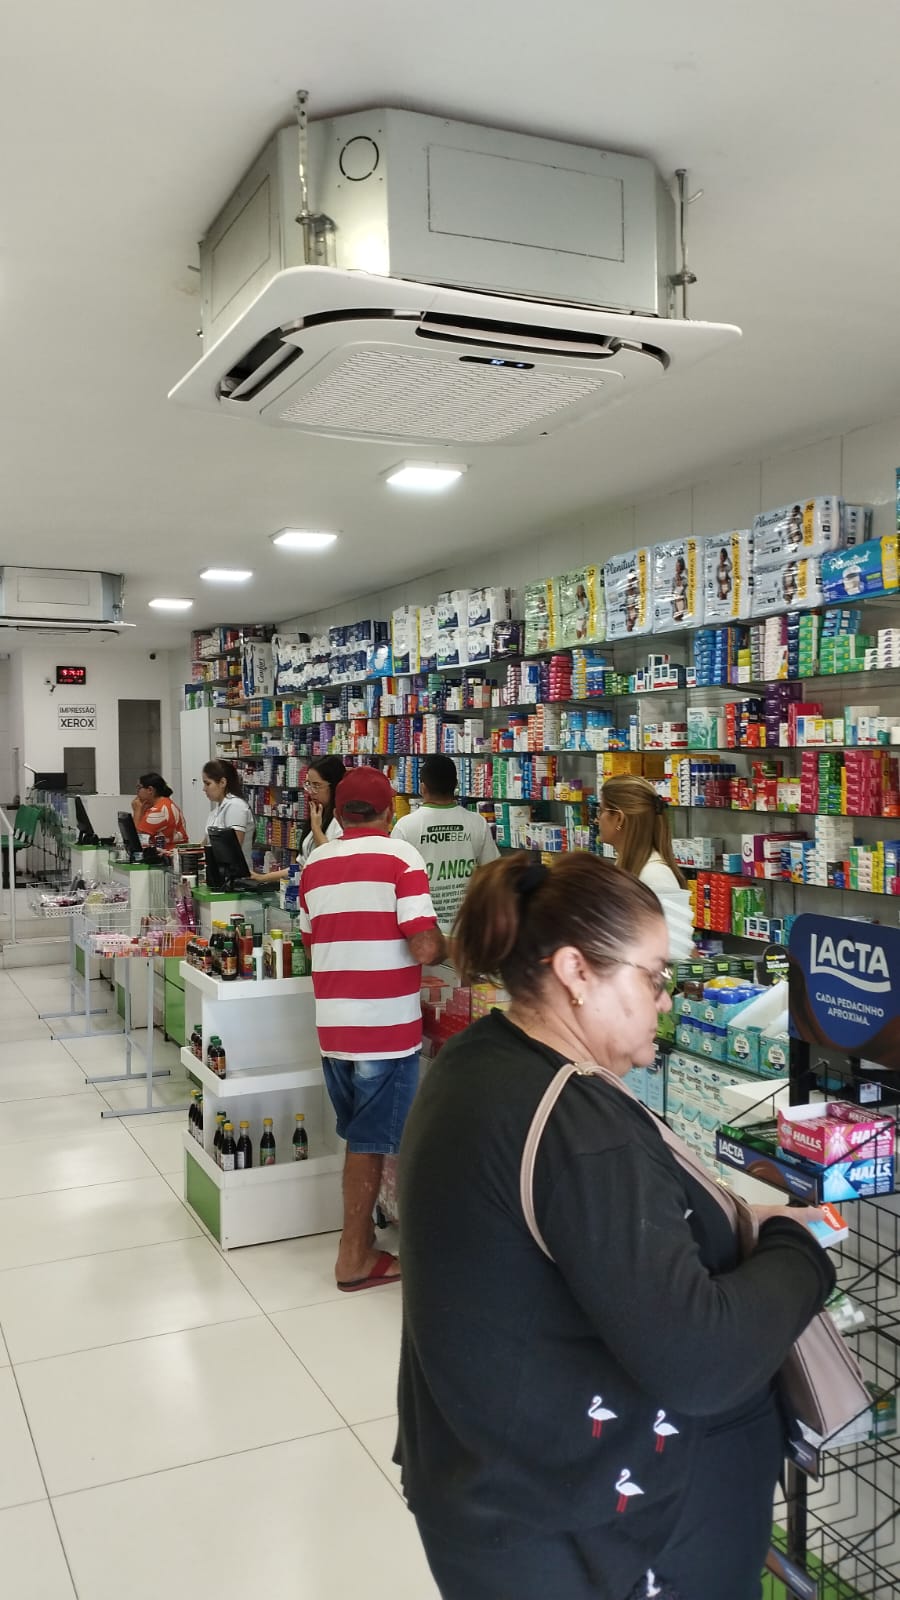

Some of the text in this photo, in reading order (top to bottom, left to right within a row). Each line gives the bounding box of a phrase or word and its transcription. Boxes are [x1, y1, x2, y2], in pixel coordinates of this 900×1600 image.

[604, 555, 637, 577] Plenitud
[829, 550, 871, 572] Plenitud
[59, 706, 95, 714] IMPRESSÃO
[60, 718, 95, 728] XEROX
[810, 933, 892, 993] LACTA
[815, 992, 885, 1018] CADA PEDACINHO
[827, 1007, 870, 1026] APROXIMA.
[793, 1131, 823, 1151] HALLS
[851, 1128, 892, 1145] HALLS
[719, 1139, 744, 1165] LACTA
[849, 1163, 892, 1181] HALLS
